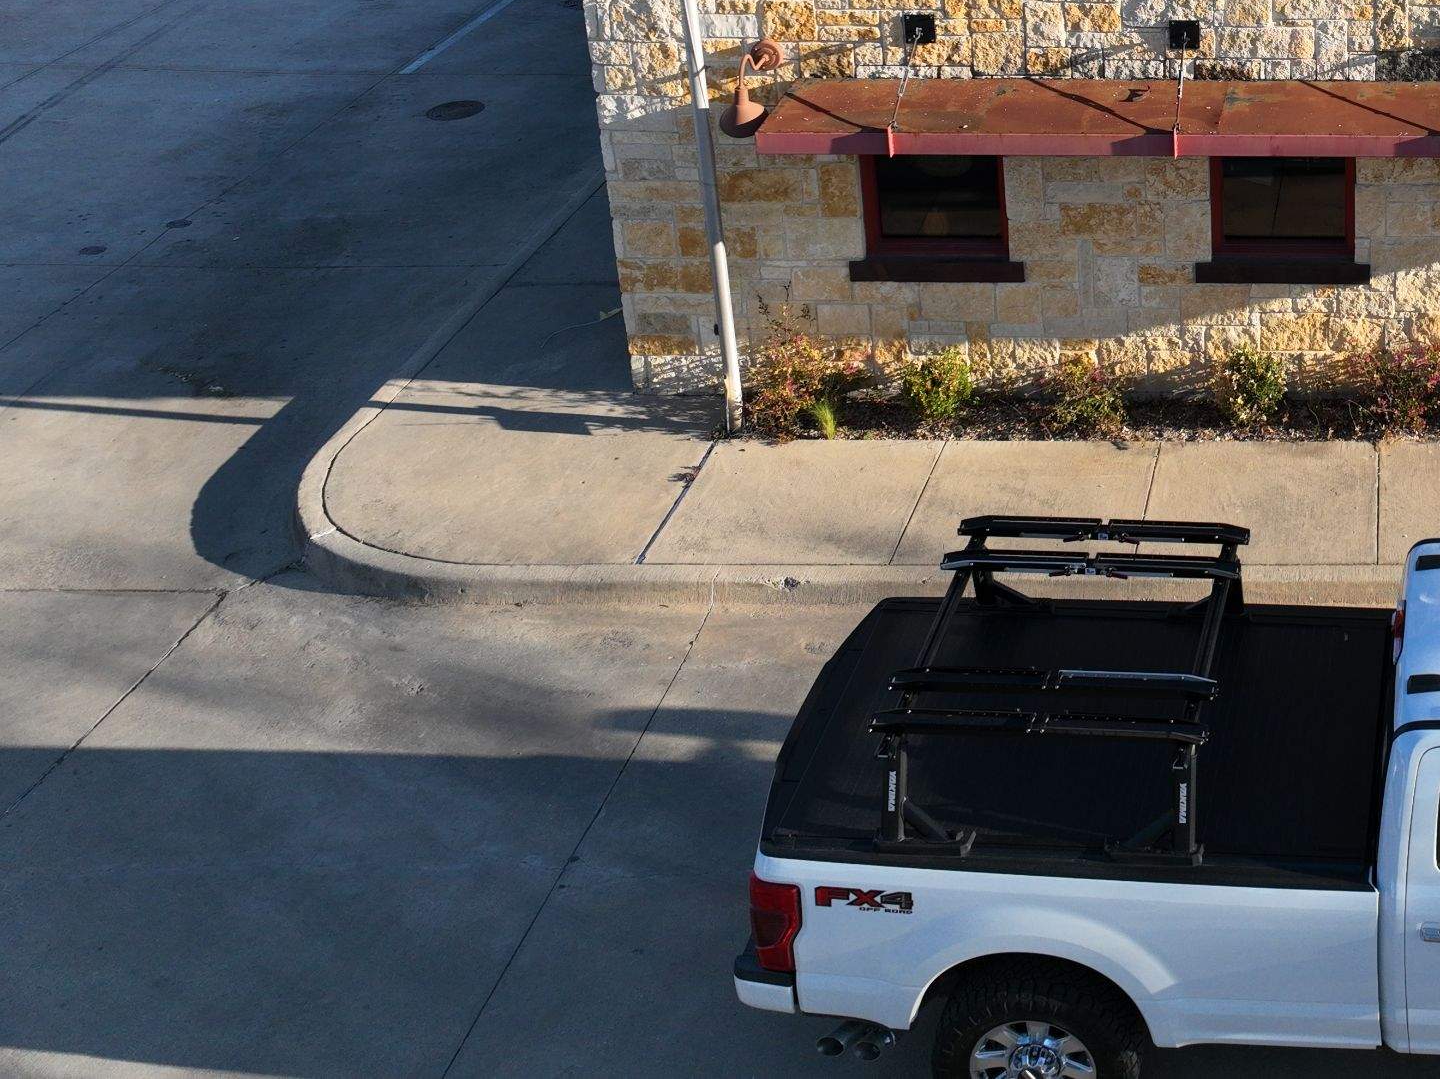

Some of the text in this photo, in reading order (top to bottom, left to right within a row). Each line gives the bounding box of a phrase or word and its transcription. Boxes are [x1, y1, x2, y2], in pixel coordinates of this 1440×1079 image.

[888, 770, 897, 812] YAKIMA
[1179, 783, 1187, 824] YAKIMA
[814, 885, 914, 910] FX4
